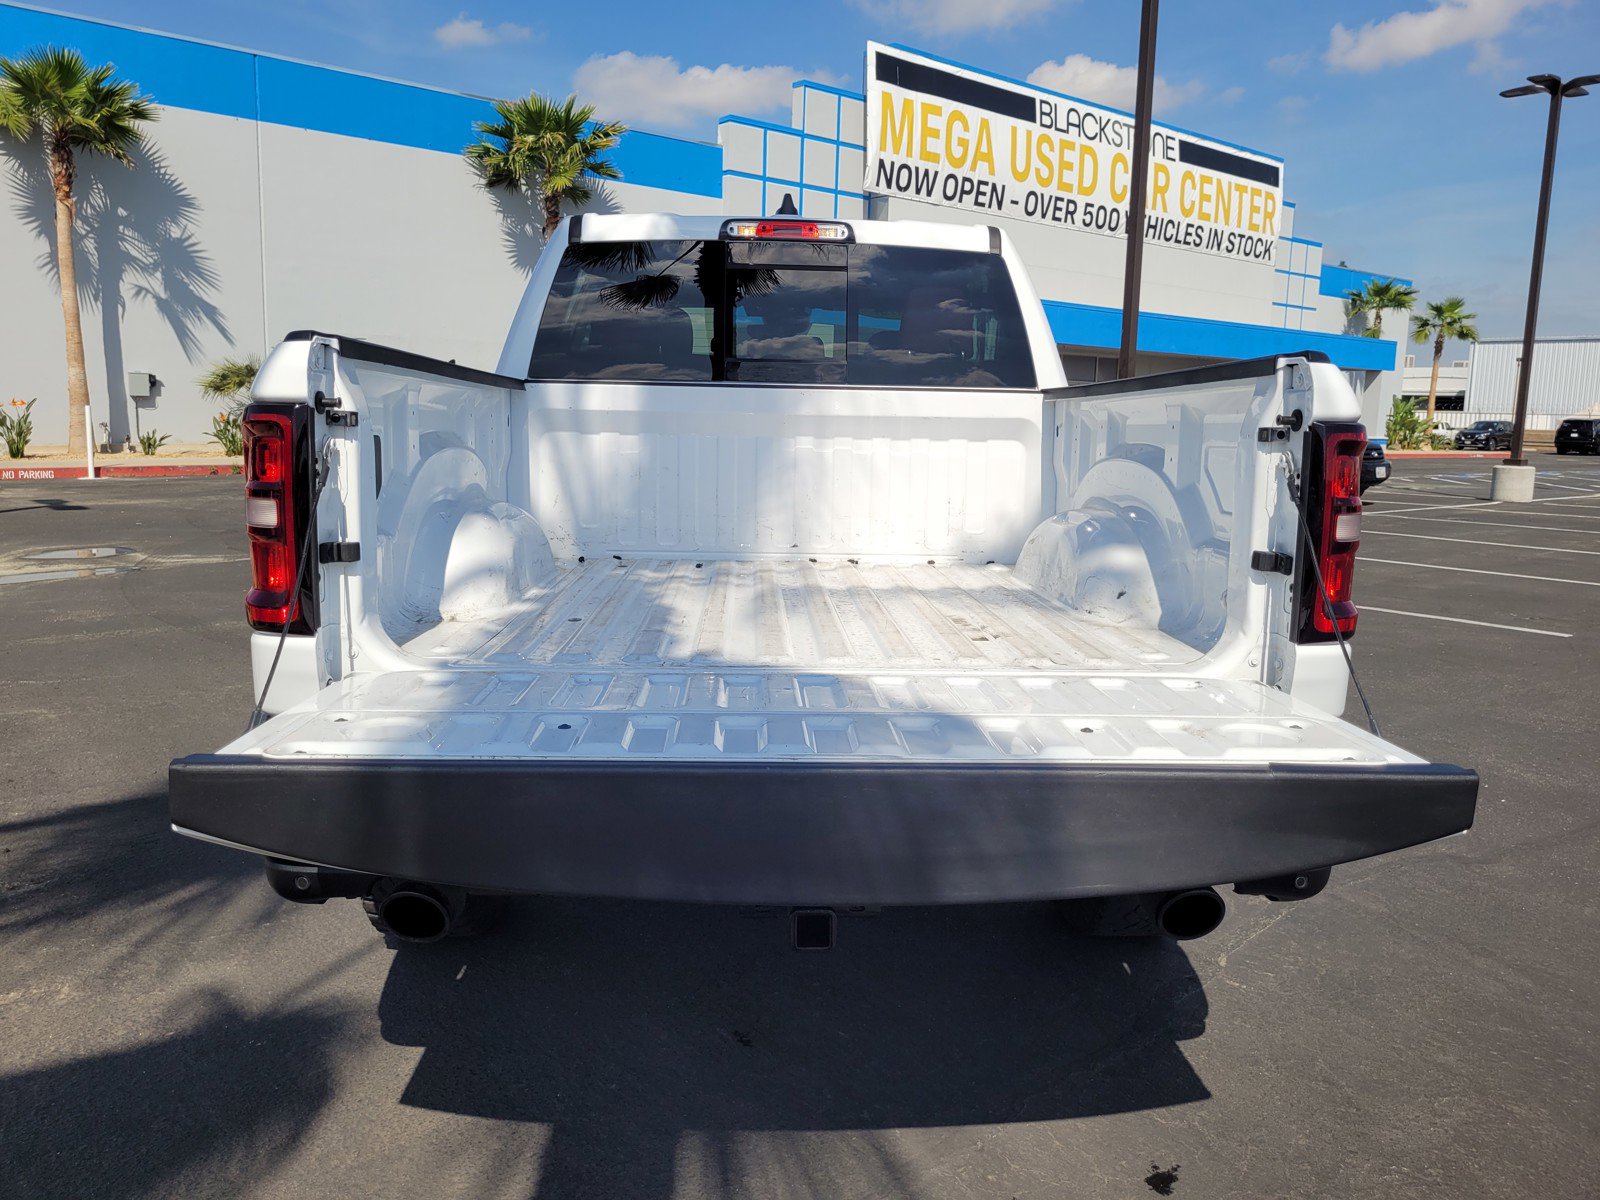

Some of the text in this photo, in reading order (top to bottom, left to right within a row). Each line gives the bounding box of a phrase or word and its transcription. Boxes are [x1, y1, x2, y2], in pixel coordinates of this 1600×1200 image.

[880, 90, 1277, 236] MEGA USED CR CENTER
[1039, 98, 1177, 162] BLACKSTNE
[876, 158, 939, 198] NOW
[942, 173, 1006, 211] OPEN
[1024, 190, 1078, 225] OVER
[1082, 202, 1120, 232] 500
[1125, 209, 1204, 248] HICLES
[1205, 227, 1224, 252] IN
[1225, 231, 1274, 261] STOCK
[2, 470, 54, 479] NO PARKING
